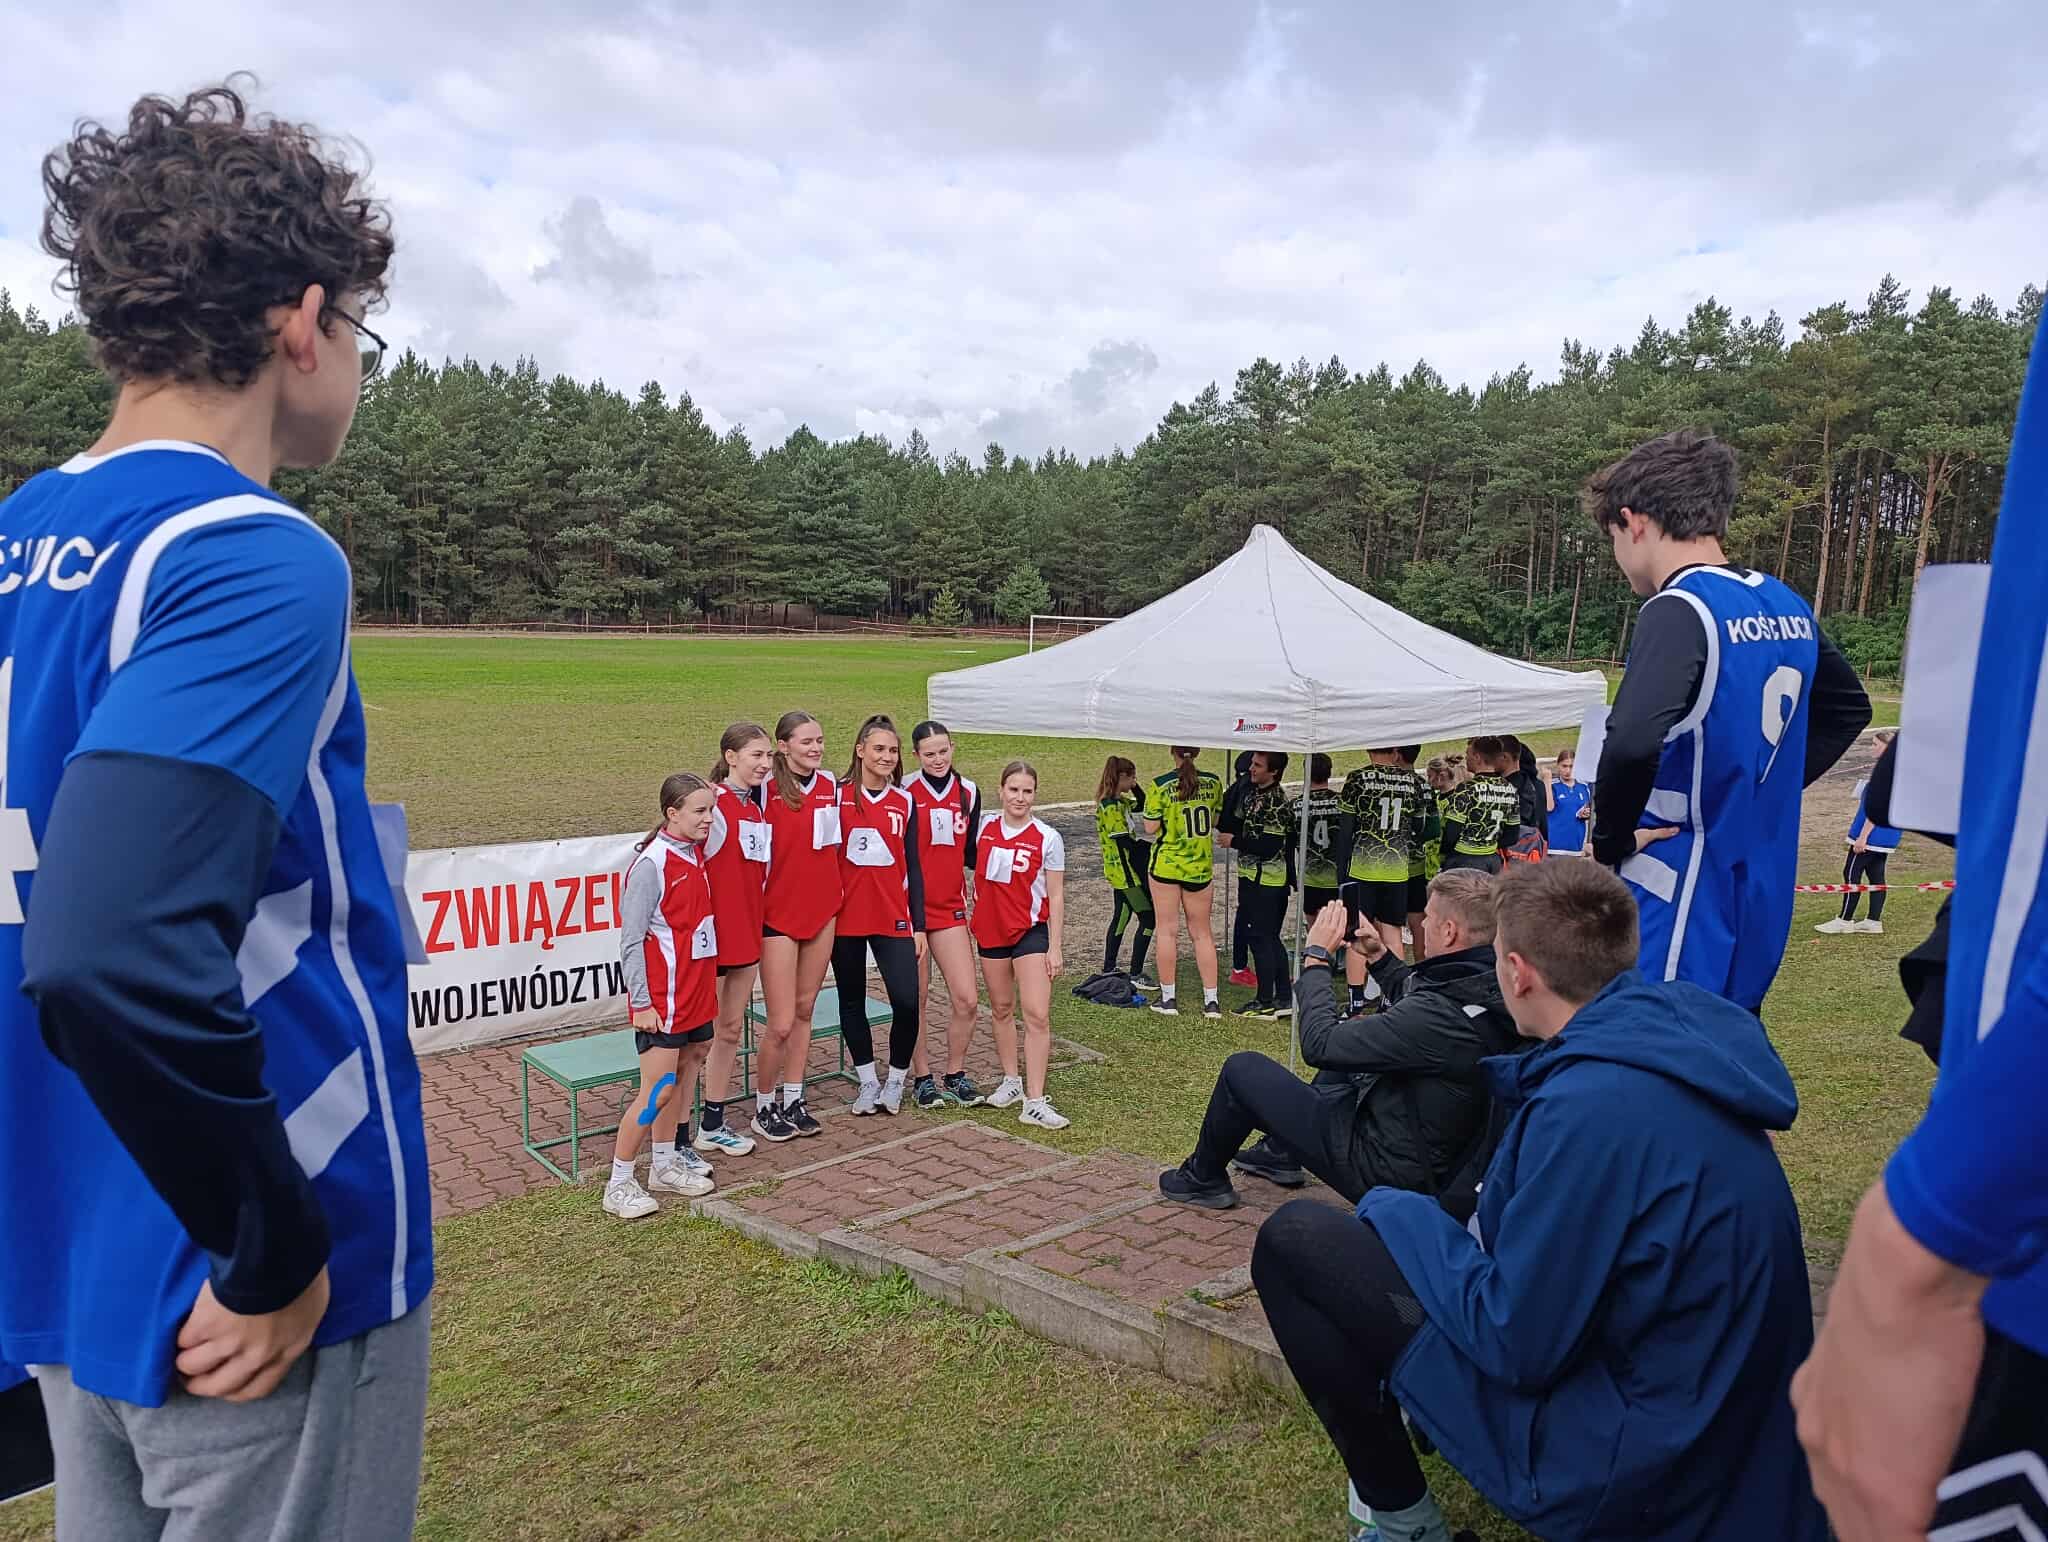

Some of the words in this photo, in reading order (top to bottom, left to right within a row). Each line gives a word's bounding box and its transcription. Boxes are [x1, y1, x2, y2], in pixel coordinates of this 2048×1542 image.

[1182, 806, 1211, 838] 10
[1379, 797, 1403, 831] 11
[749, 834, 756, 850] 3
[858, 836, 868, 851] 3
[1313, 820, 1330, 849] 4
[1012, 849, 1032, 873] 5
[700, 931, 708, 949] 3
